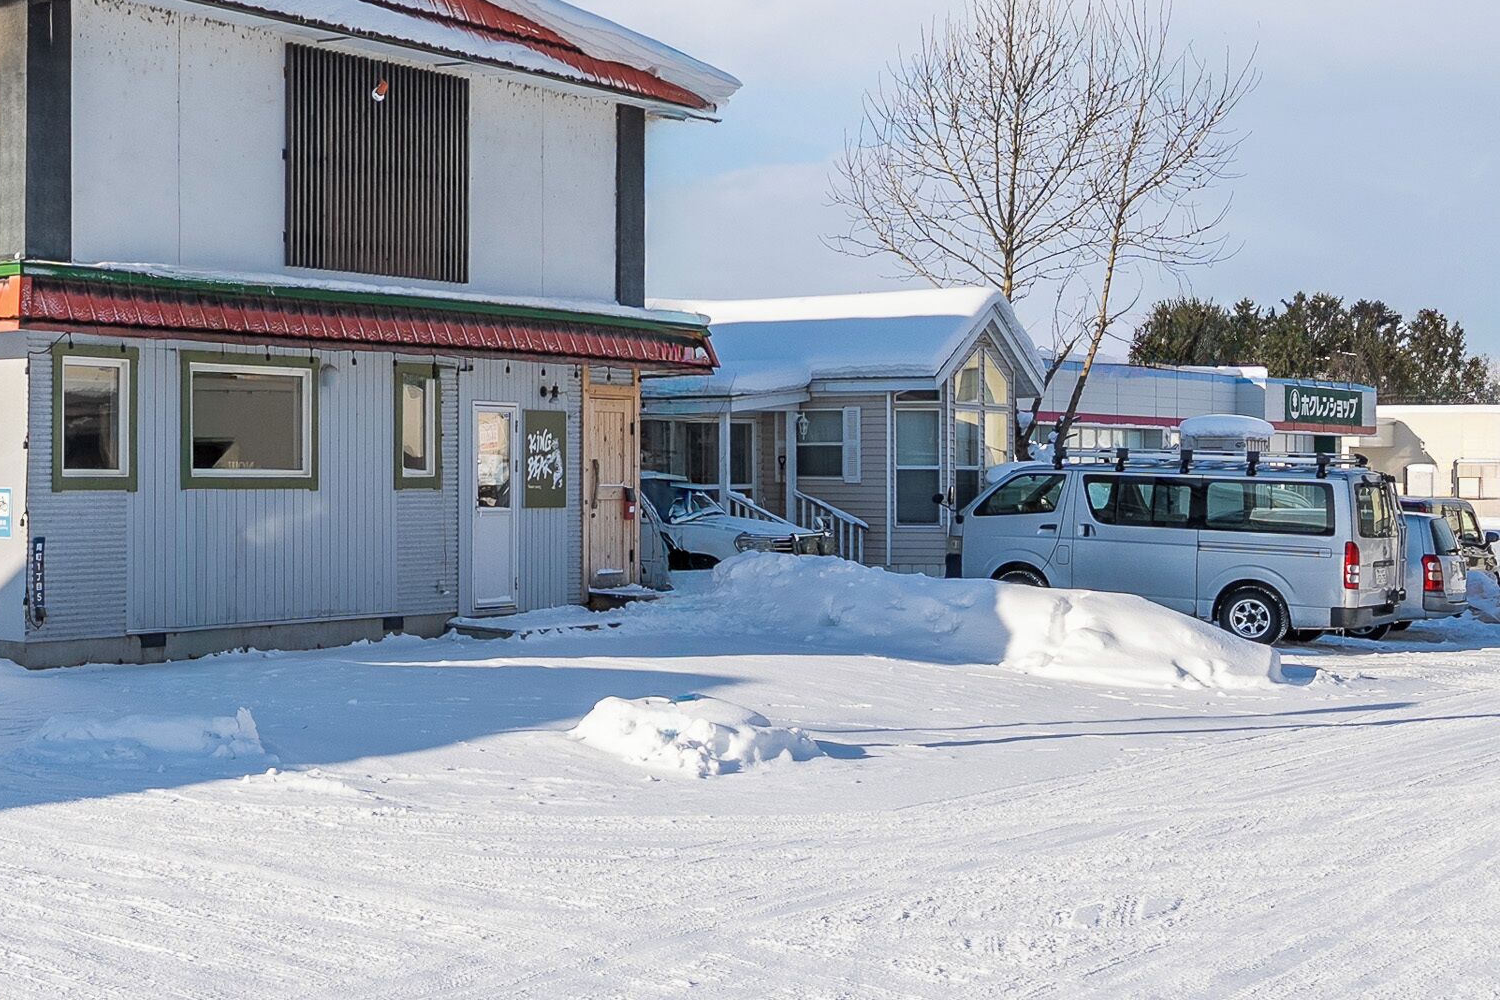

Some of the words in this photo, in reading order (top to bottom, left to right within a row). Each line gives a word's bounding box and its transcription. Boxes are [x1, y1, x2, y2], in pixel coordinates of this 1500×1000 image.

[1301, 394, 1358, 418] ホクレンショップ
